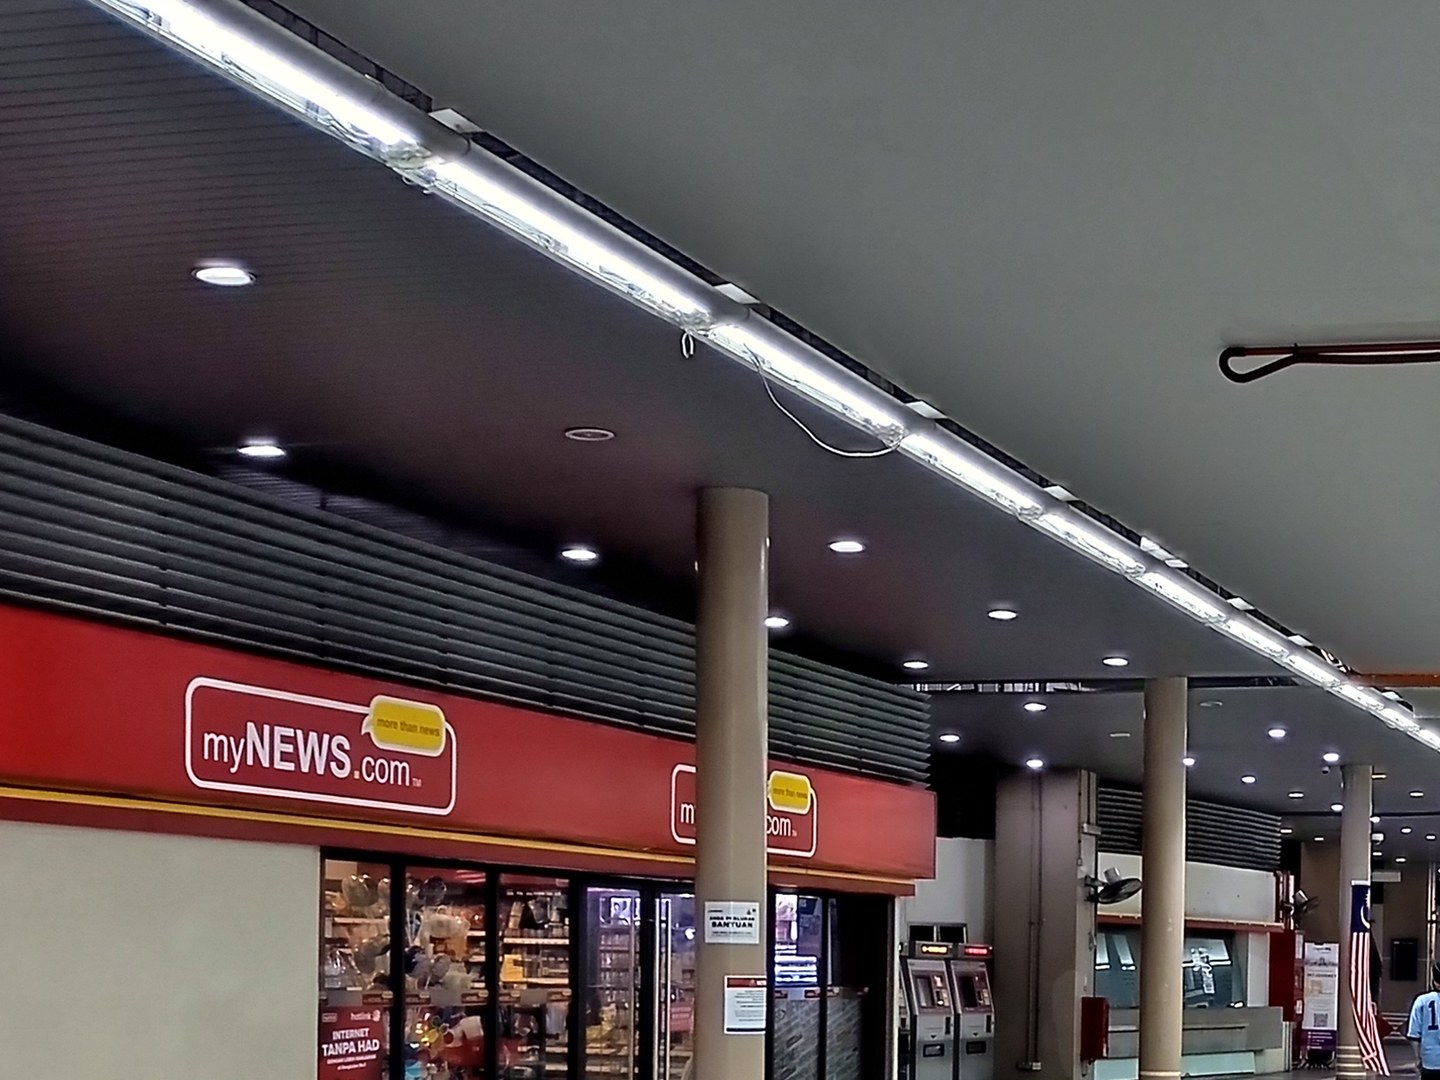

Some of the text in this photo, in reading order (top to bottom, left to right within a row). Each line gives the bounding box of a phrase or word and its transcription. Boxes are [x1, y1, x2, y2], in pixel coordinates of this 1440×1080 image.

[376, 718, 398, 730] more
[420, 725, 440, 737] news
[203, 721, 411, 787] myNEWS.com
[332, 1027, 370, 1040] INTERNET
[321, 1039, 380, 1057] TANPA HAD
